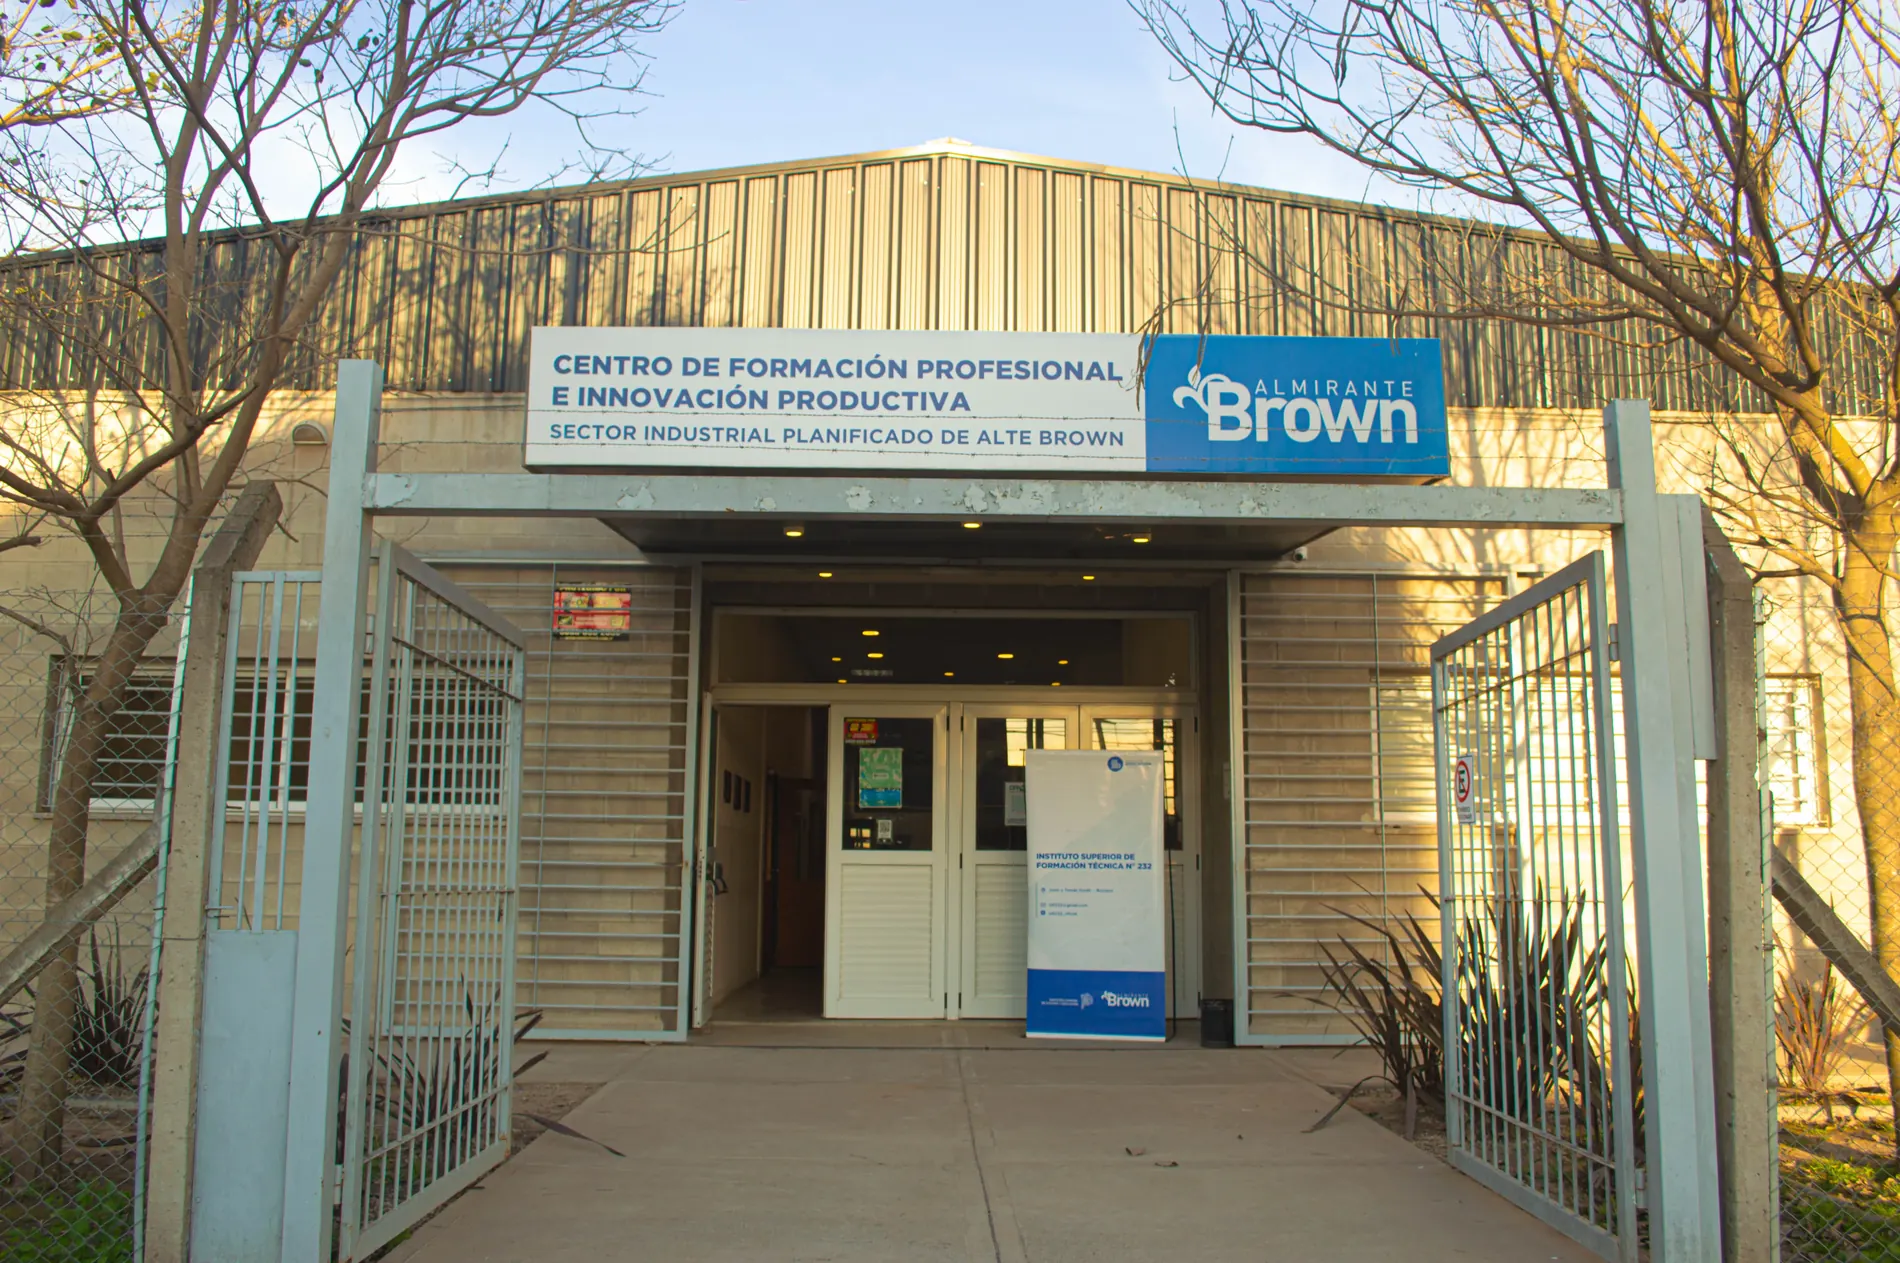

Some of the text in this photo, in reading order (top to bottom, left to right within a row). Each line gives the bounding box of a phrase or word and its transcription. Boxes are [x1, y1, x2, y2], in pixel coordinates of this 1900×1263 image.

[553, 353, 1123, 382] CENTRO DE FORMACIÓN PROFESIONAL
[551, 383, 971, 412] E INNOVACIÓN PRODUCTIVA
[1254, 379, 1413, 397] ALMIRANTE
[1207, 380, 1419, 444] Brown
[549, 423, 1124, 447] SECTOR INDUSTRIAL PLANIFICADO DE ALTE BROWN
[1036, 861, 1086, 869] FORMACIÓN
[1088, 862, 1124, 870] TÉCNICA
[1081, 853, 1122, 861] SUPERIOR
[1124, 853, 1136, 861] DE
[1107, 991, 1150, 1008] Brown
